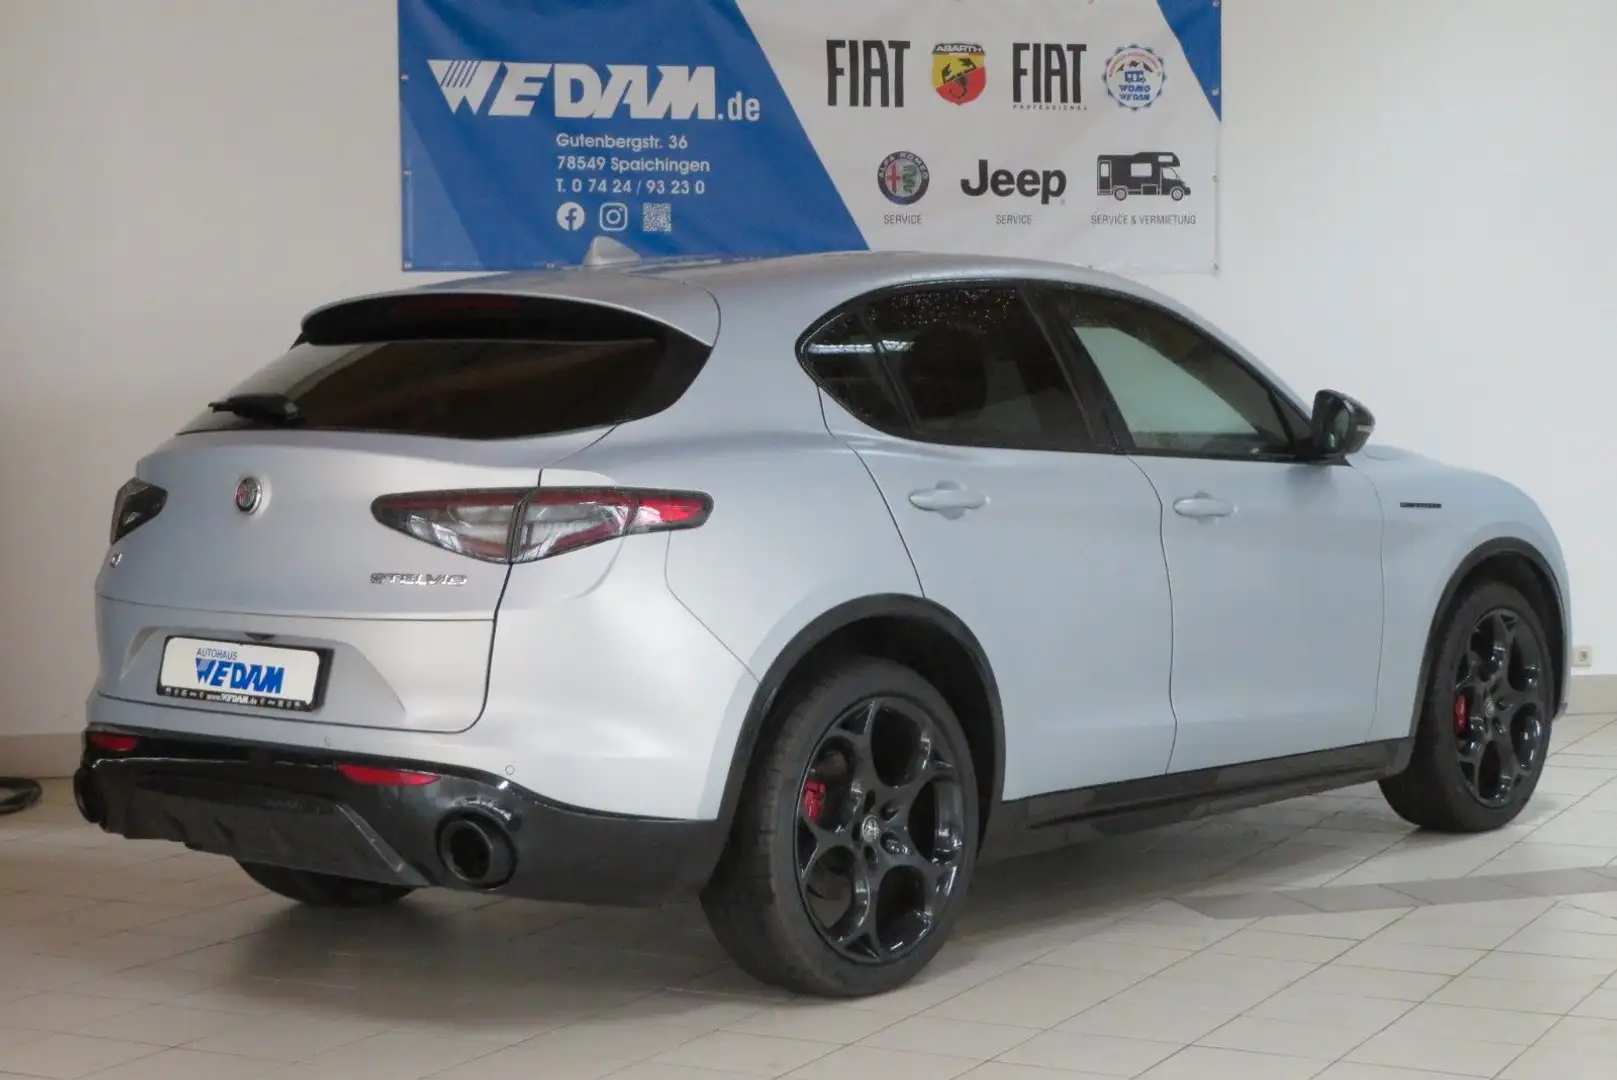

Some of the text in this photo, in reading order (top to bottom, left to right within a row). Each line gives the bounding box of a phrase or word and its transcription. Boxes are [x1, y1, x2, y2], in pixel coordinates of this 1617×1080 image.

[936, 44, 983, 53] ABARTH
[826, 39, 911, 107] FIAT
[1012, 43, 1087, 104] FIAT
[556, 133, 688, 152] Gutenbergstr. 36
[557, 156, 710, 175] 78549 Spaichingen
[556, 178, 567, 193] T.
[571, 178, 582, 193] 0
[588, 179, 608, 193] 74
[612, 180, 632, 194] 24
[646, 180, 665, 194] 93
[670, 180, 690, 194] 23
[695, 180, 705, 194] 0
[960, 159, 1067, 205] Jeep
[883, 214, 923, 225] SERVICE
[995, 214, 1033, 225] SERVICE
[1090, 214, 1129, 225] SERVICE
[1139, 214, 1197, 225] VERMIETUNG
[370, 572, 468, 586] STELVIO
[196, 648, 238, 660] AUTOHAUS
[195, 658, 285, 694] WEDAM
